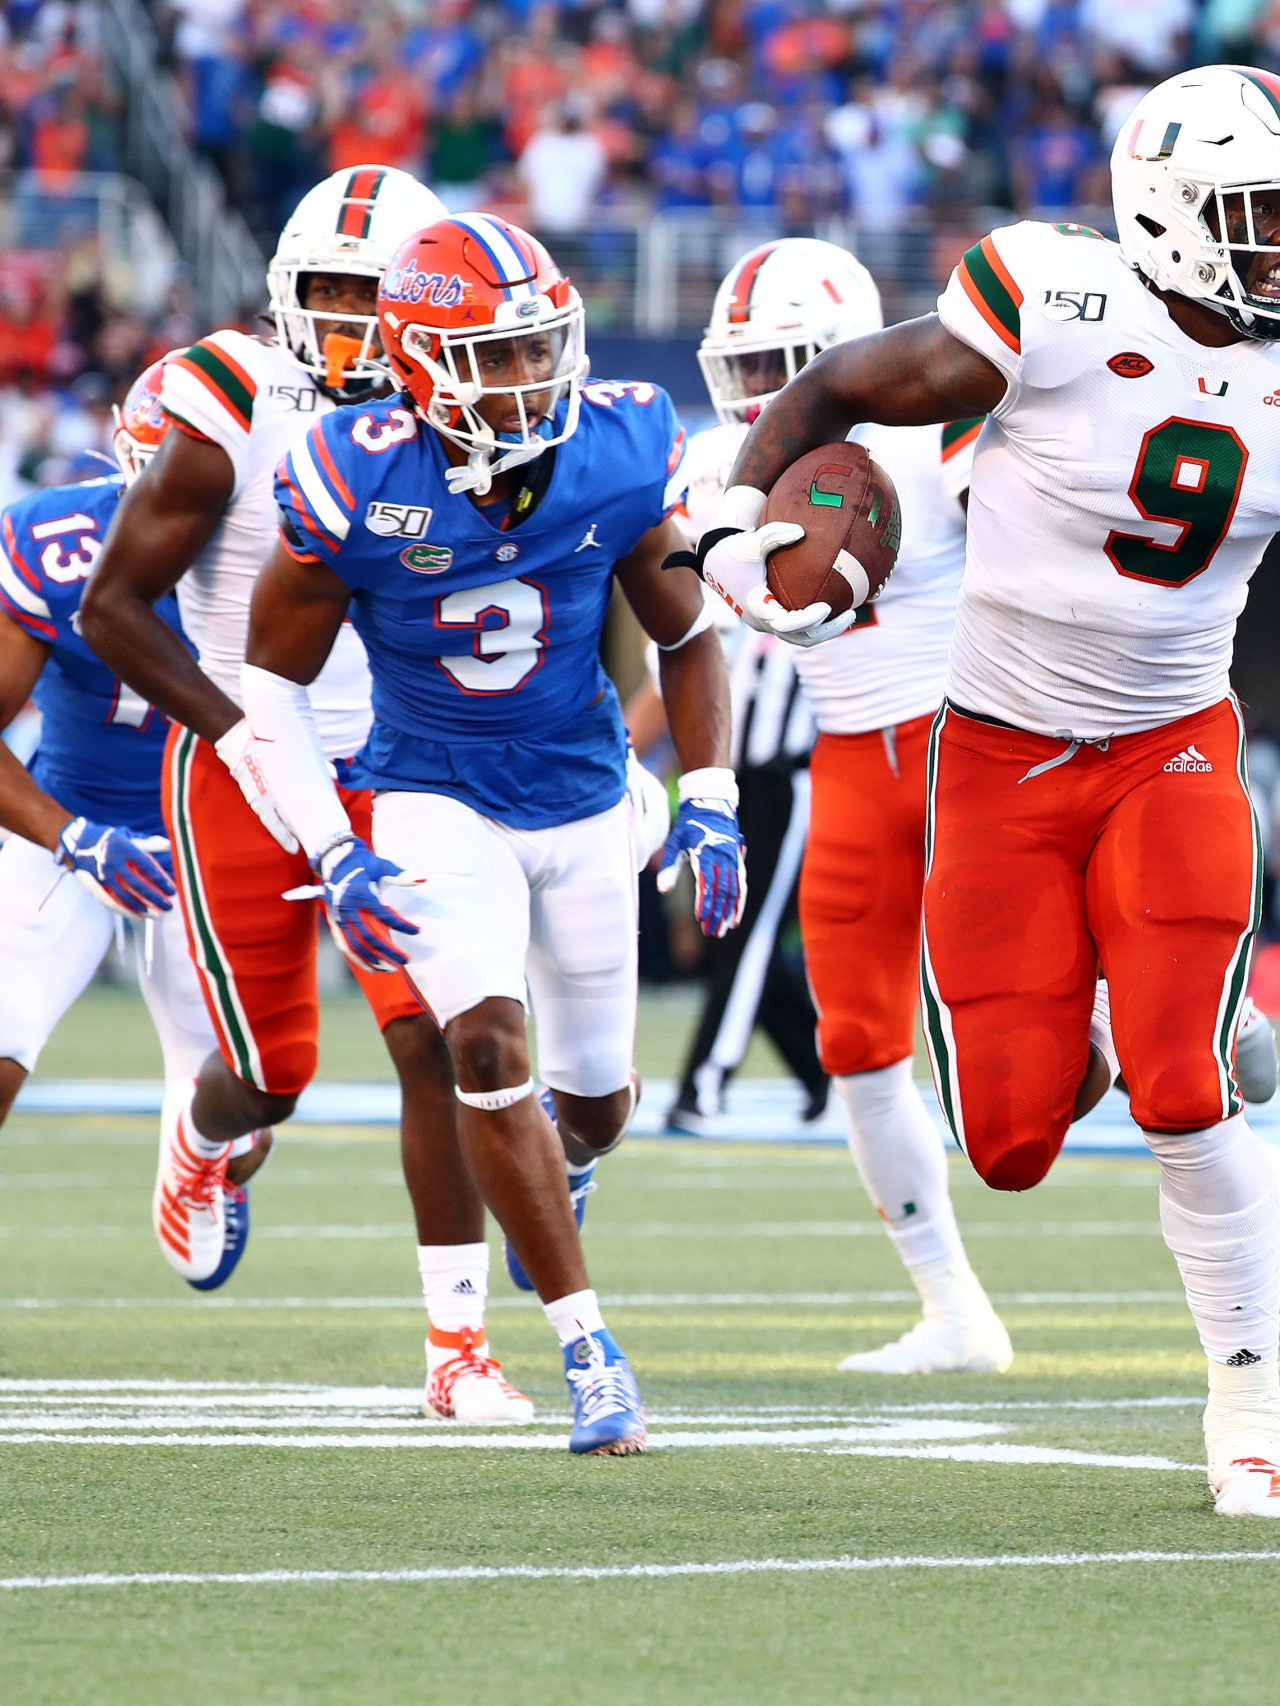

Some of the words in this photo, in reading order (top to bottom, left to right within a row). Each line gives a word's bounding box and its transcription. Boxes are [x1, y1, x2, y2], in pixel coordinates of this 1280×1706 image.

[1041, 290, 1107, 321] 150
[1115, 358, 1145, 370] ACC
[1198, 377, 1229, 397] U
[352, 407, 418, 454] 3
[1103, 415, 1249, 588] 9
[367, 503, 430, 536] 150
[31, 513, 101, 585] 13
[434, 576, 550, 696] 3
[1163, 758, 1213, 773] adidas
[1227, 1354, 1262, 1367] adidas
